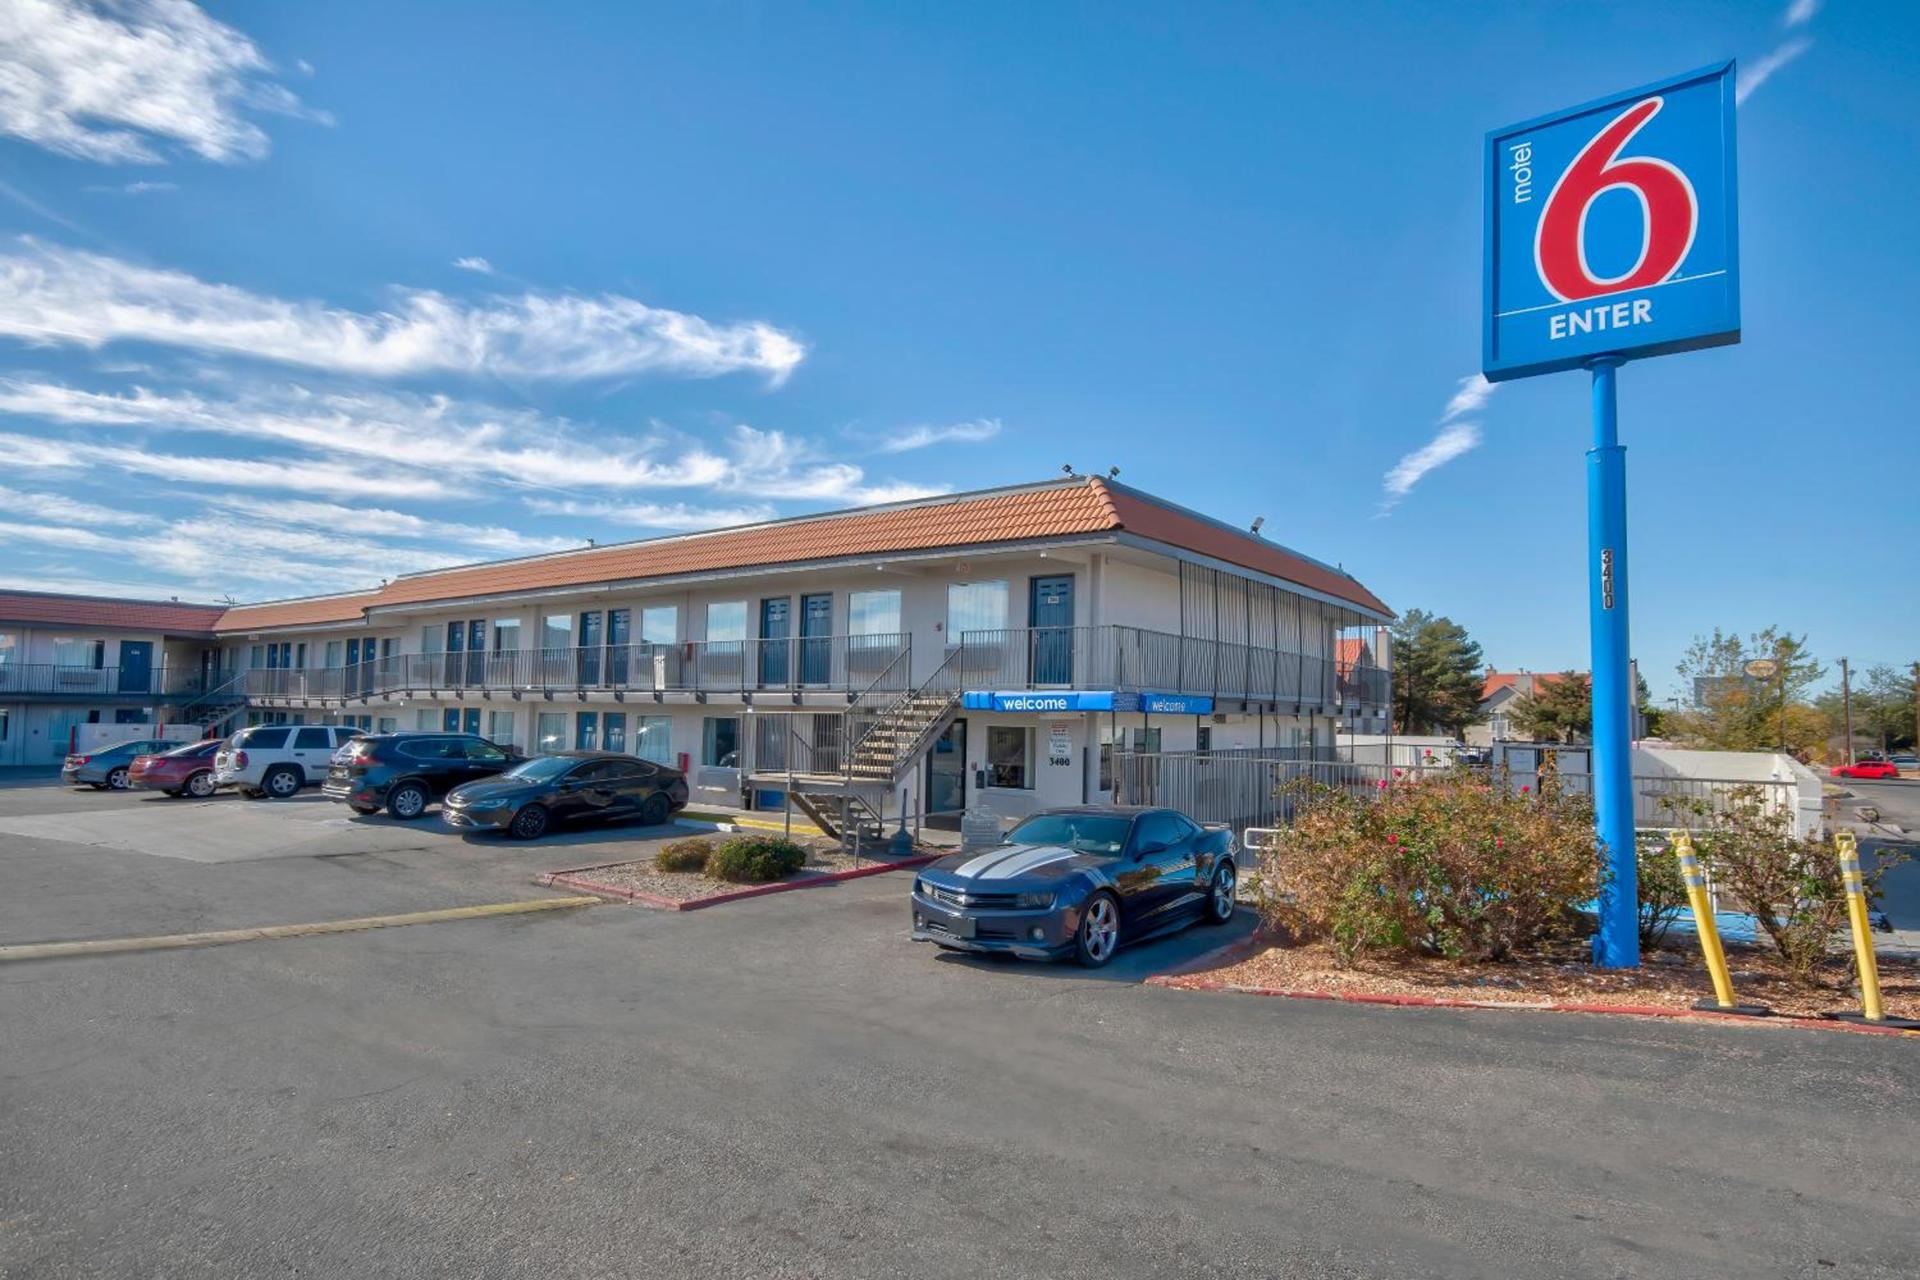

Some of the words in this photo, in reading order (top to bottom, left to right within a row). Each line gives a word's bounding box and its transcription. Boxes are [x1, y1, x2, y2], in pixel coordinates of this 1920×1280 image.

[1510, 141, 1532, 204] motel
[1533, 96, 1699, 303] 6
[1549, 299, 1653, 340] ENTER
[1602, 549, 1614, 609] 3400
[1003, 696, 1067, 710] welcome
[1152, 699, 1186, 712] welcome
[1049, 757, 1070, 767] 3400
